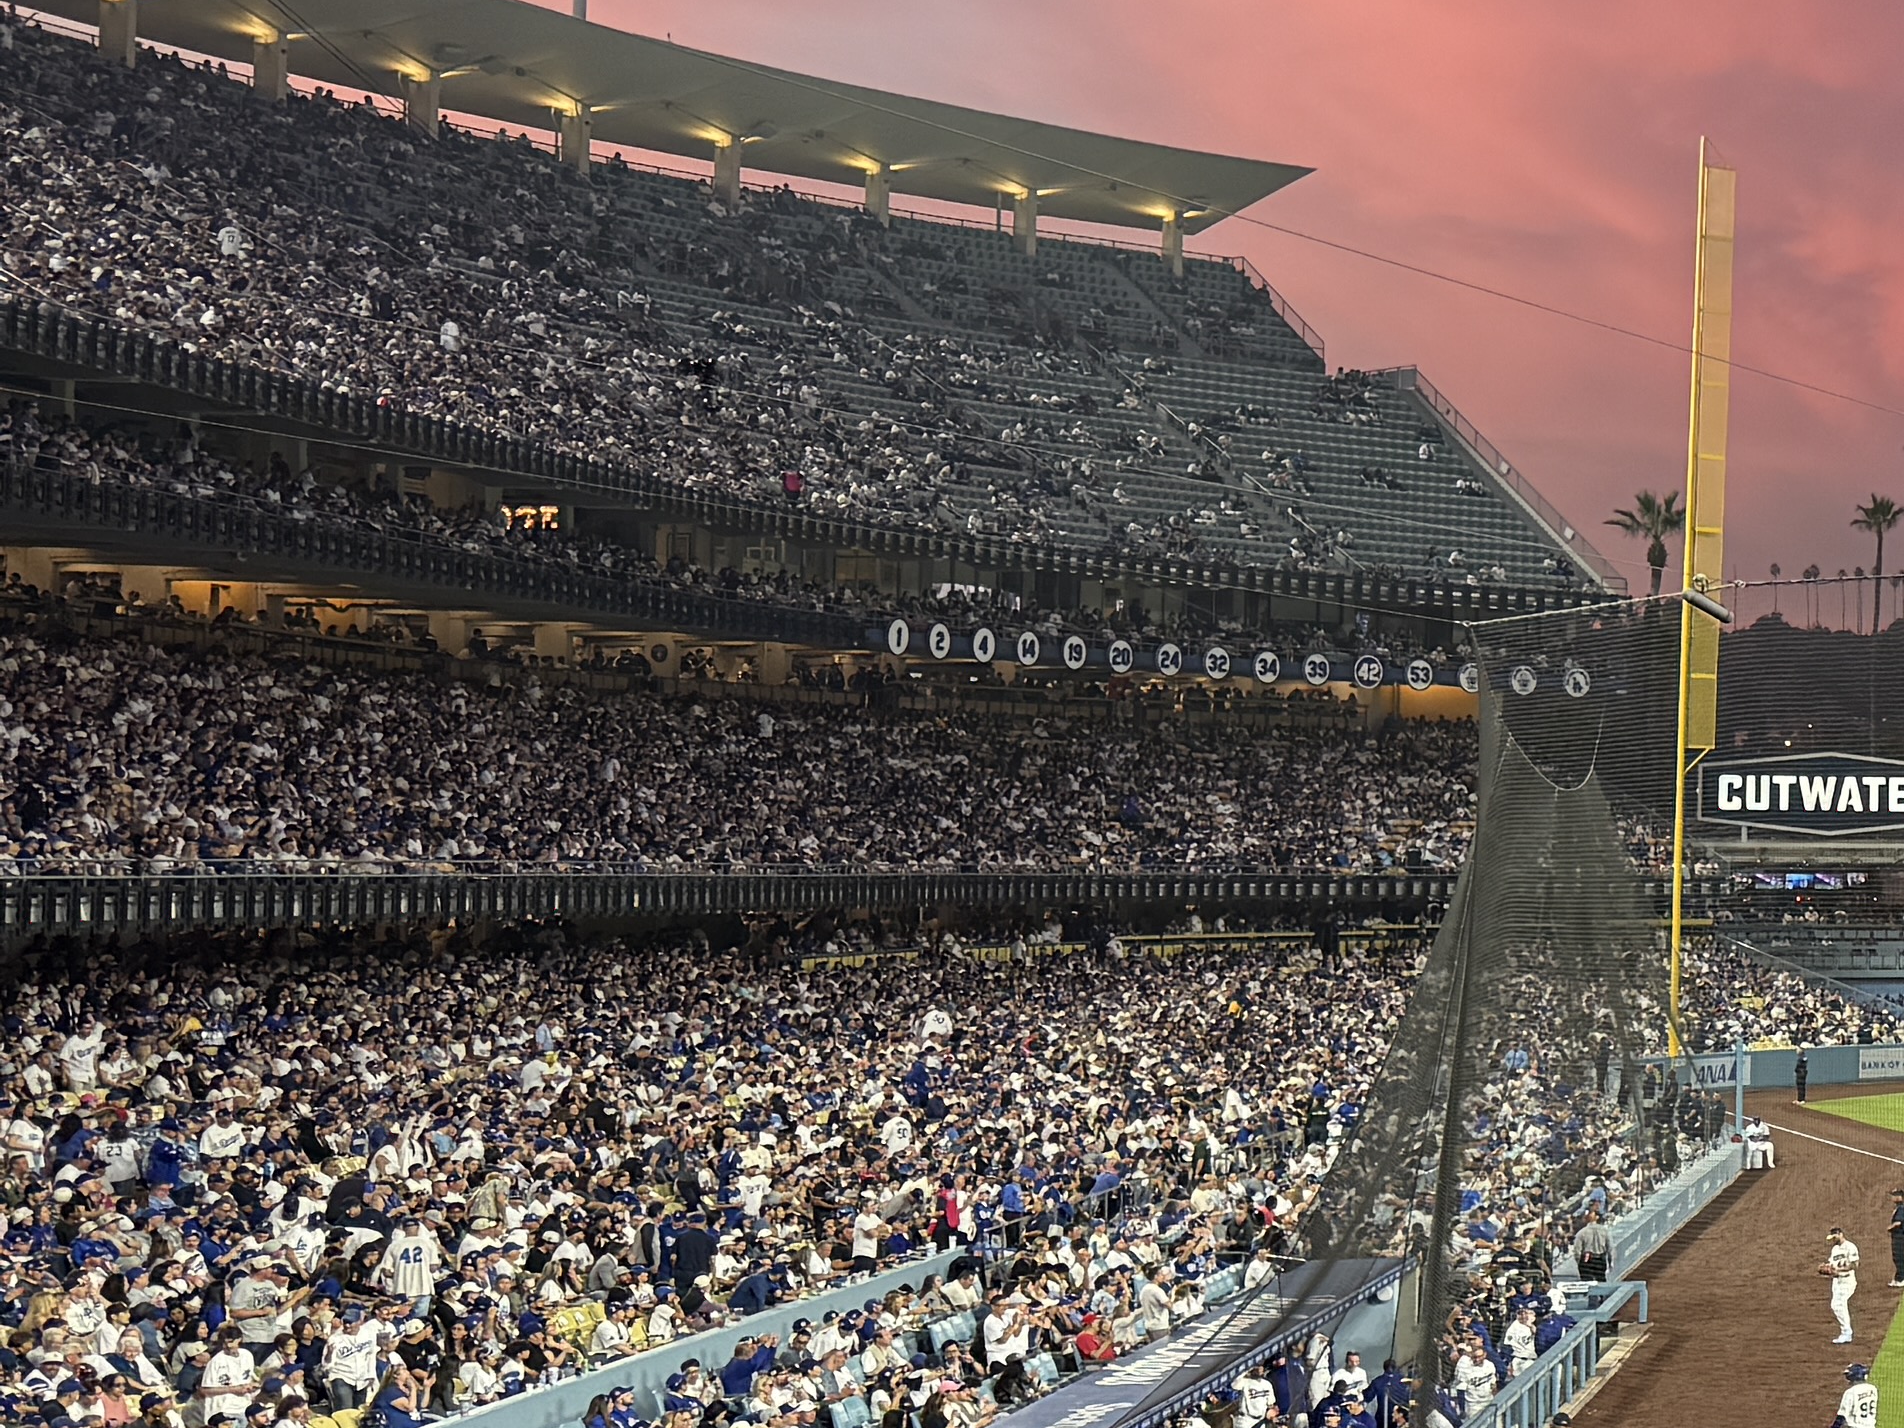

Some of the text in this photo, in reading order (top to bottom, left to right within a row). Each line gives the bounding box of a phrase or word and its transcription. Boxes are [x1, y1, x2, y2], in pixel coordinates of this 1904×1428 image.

[935, 632, 945, 650] 2
[978, 636, 989, 654] 4
[1021, 638, 1035, 657] 14
[1067, 643, 1083, 662] 19
[1112, 647, 1130, 665] 20
[1160, 649, 1180, 668] 24
[1208, 654, 1227, 673] 32
[1258, 658, 1278, 676] 34
[1308, 662, 1327, 678] 39
[1358, 663, 1379, 681] 42
[1410, 666, 1430, 683] 53
[1861, 1059, 1886, 1071] BANK
[1887, 1058, 1902, 1069] OF
[399, 1246, 423, 1264] 42
